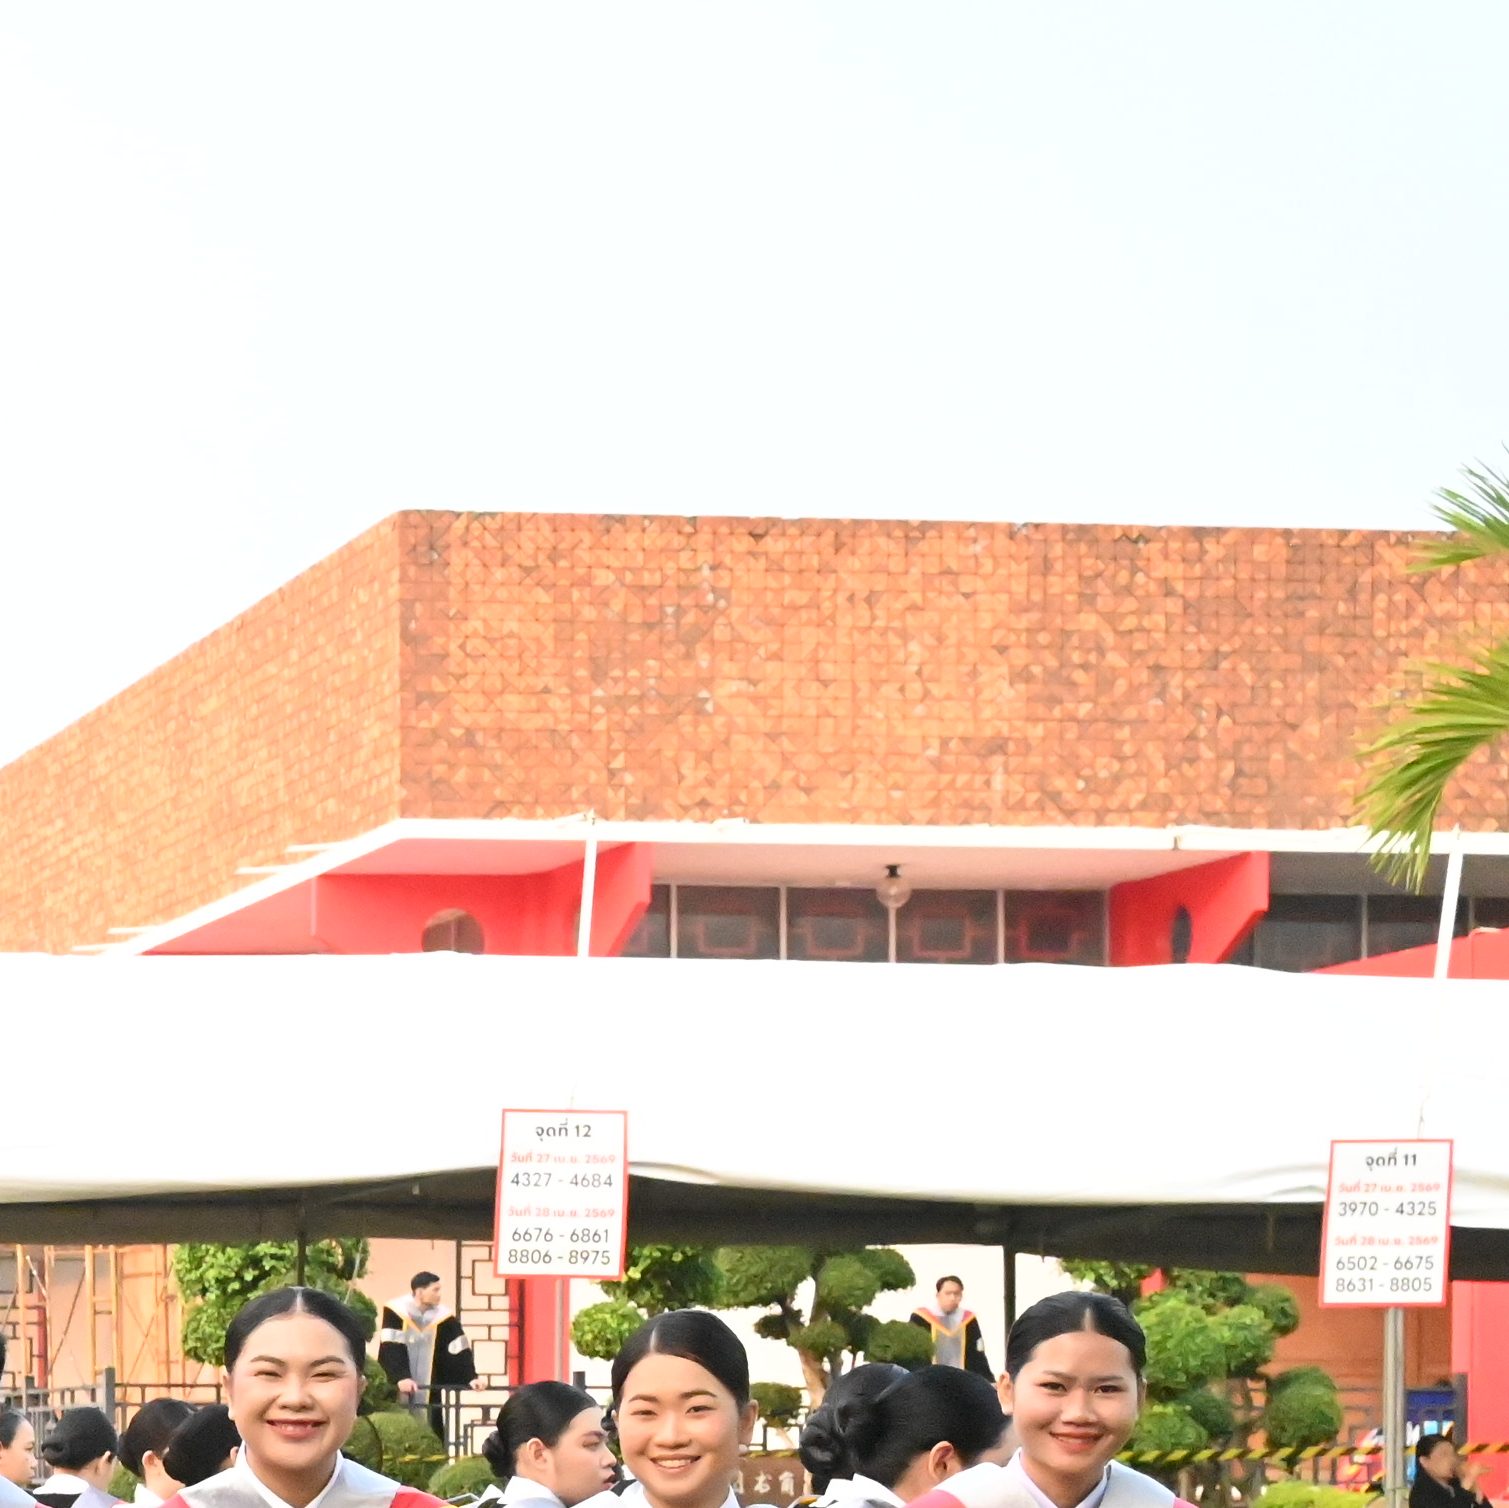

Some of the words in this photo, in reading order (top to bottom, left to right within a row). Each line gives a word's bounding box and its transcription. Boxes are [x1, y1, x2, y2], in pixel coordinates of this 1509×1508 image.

[536, 1118, 568, 1141] จุดที่
[575, 1125, 591, 1137] 12
[511, 1150, 533, 1163] วันที่
[537, 1154, 550, 1163] 27
[585, 1154, 616, 1164] 2569
[1366, 1147, 1397, 1171] จุดที่
[1404, 1154, 1417, 1166] 11
[511, 1173, 552, 1187] 4327
[570, 1173, 613, 1187] 4684
[1339, 1179, 1360, 1193] วันที่
[1365, 1183, 1377, 1192] 27
[1411, 1183, 1440, 1192] 2569
[508, 1204, 530, 1217] วันที่
[535, 1208, 549, 1217] 28
[585, 1208, 615, 1218] 2569
[1338, 1202, 1378, 1216] 3970
[1396, 1201, 1437, 1216] 4325
[512, 1228, 553, 1242] 6676
[570, 1228, 608, 1243] 6861
[1335, 1233, 1357, 1246] วันที่
[1361, 1236, 1374, 1245] 28
[1409, 1236, 1438, 1245] 2569
[508, 1249, 552, 1264] 8806
[569, 1250, 610, 1265] 8975
[1336, 1256, 1377, 1270] 6502
[1394, 1256, 1434, 1270] 6675
[1336, 1278, 1373, 1292] 8631
[1390, 1277, 1432, 1292] 8805
